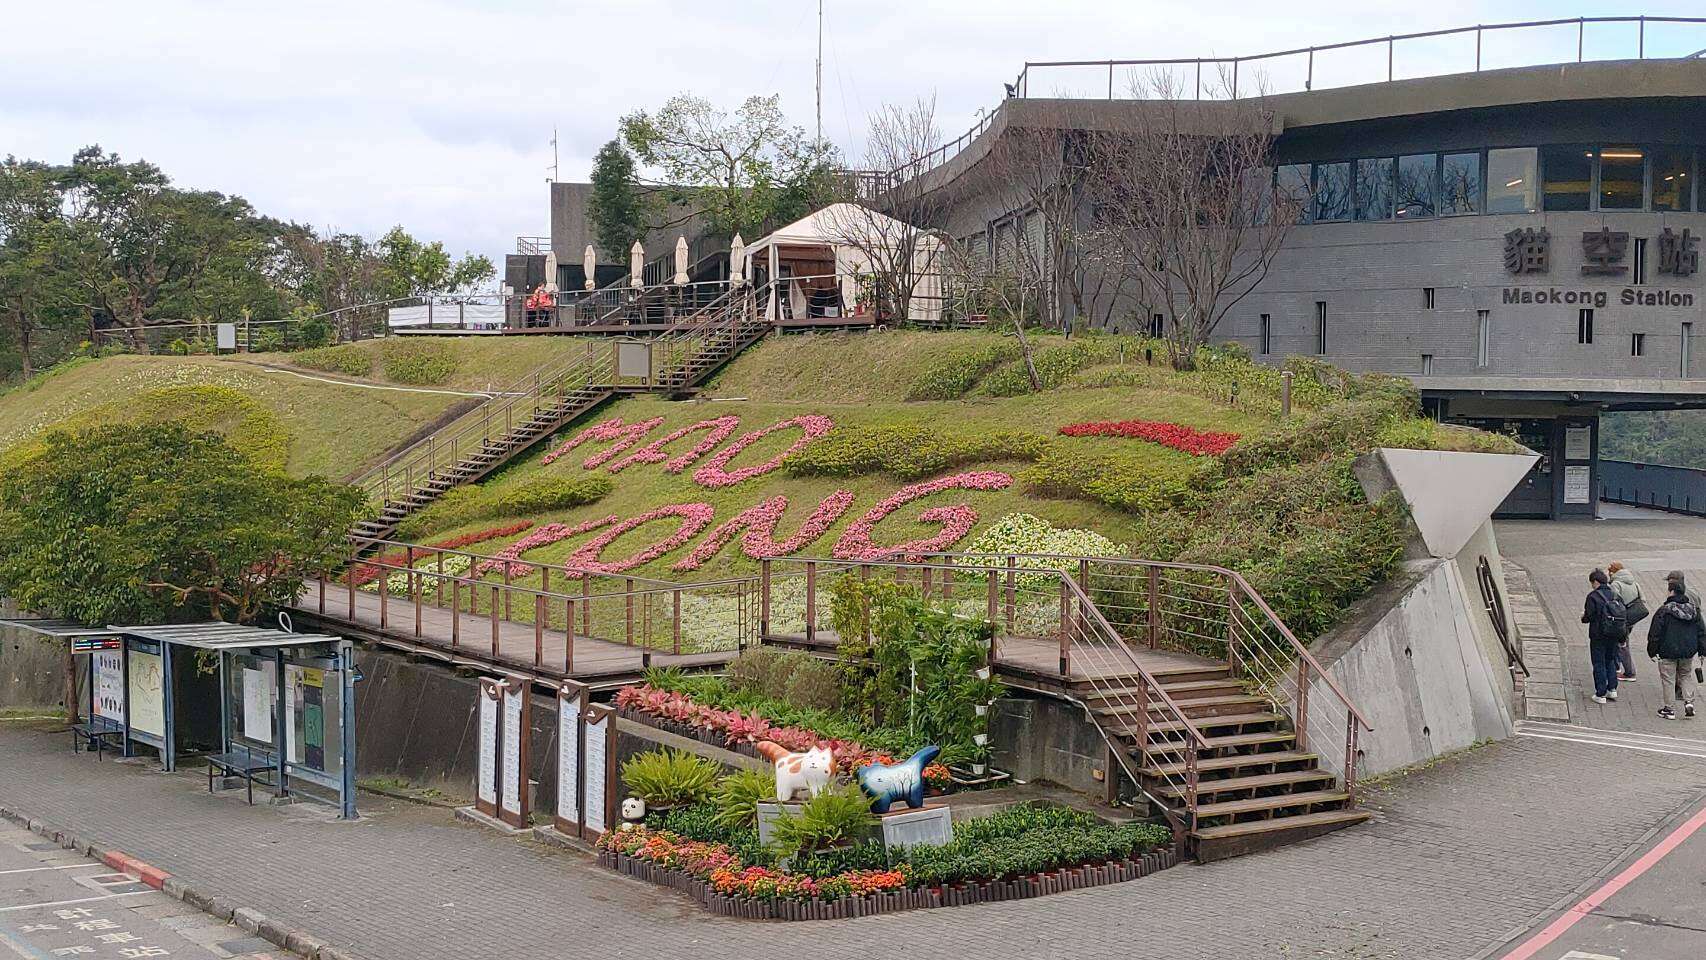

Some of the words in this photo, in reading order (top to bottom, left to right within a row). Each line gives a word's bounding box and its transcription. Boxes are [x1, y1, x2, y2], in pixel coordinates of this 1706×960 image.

[1504, 227, 1701, 275] 貓空站
[1503, 288, 1607, 307] Maokong
[1621, 289, 1694, 306] Station
[541, 415, 836, 489] MAO
[460, 470, 1014, 587] KONG
